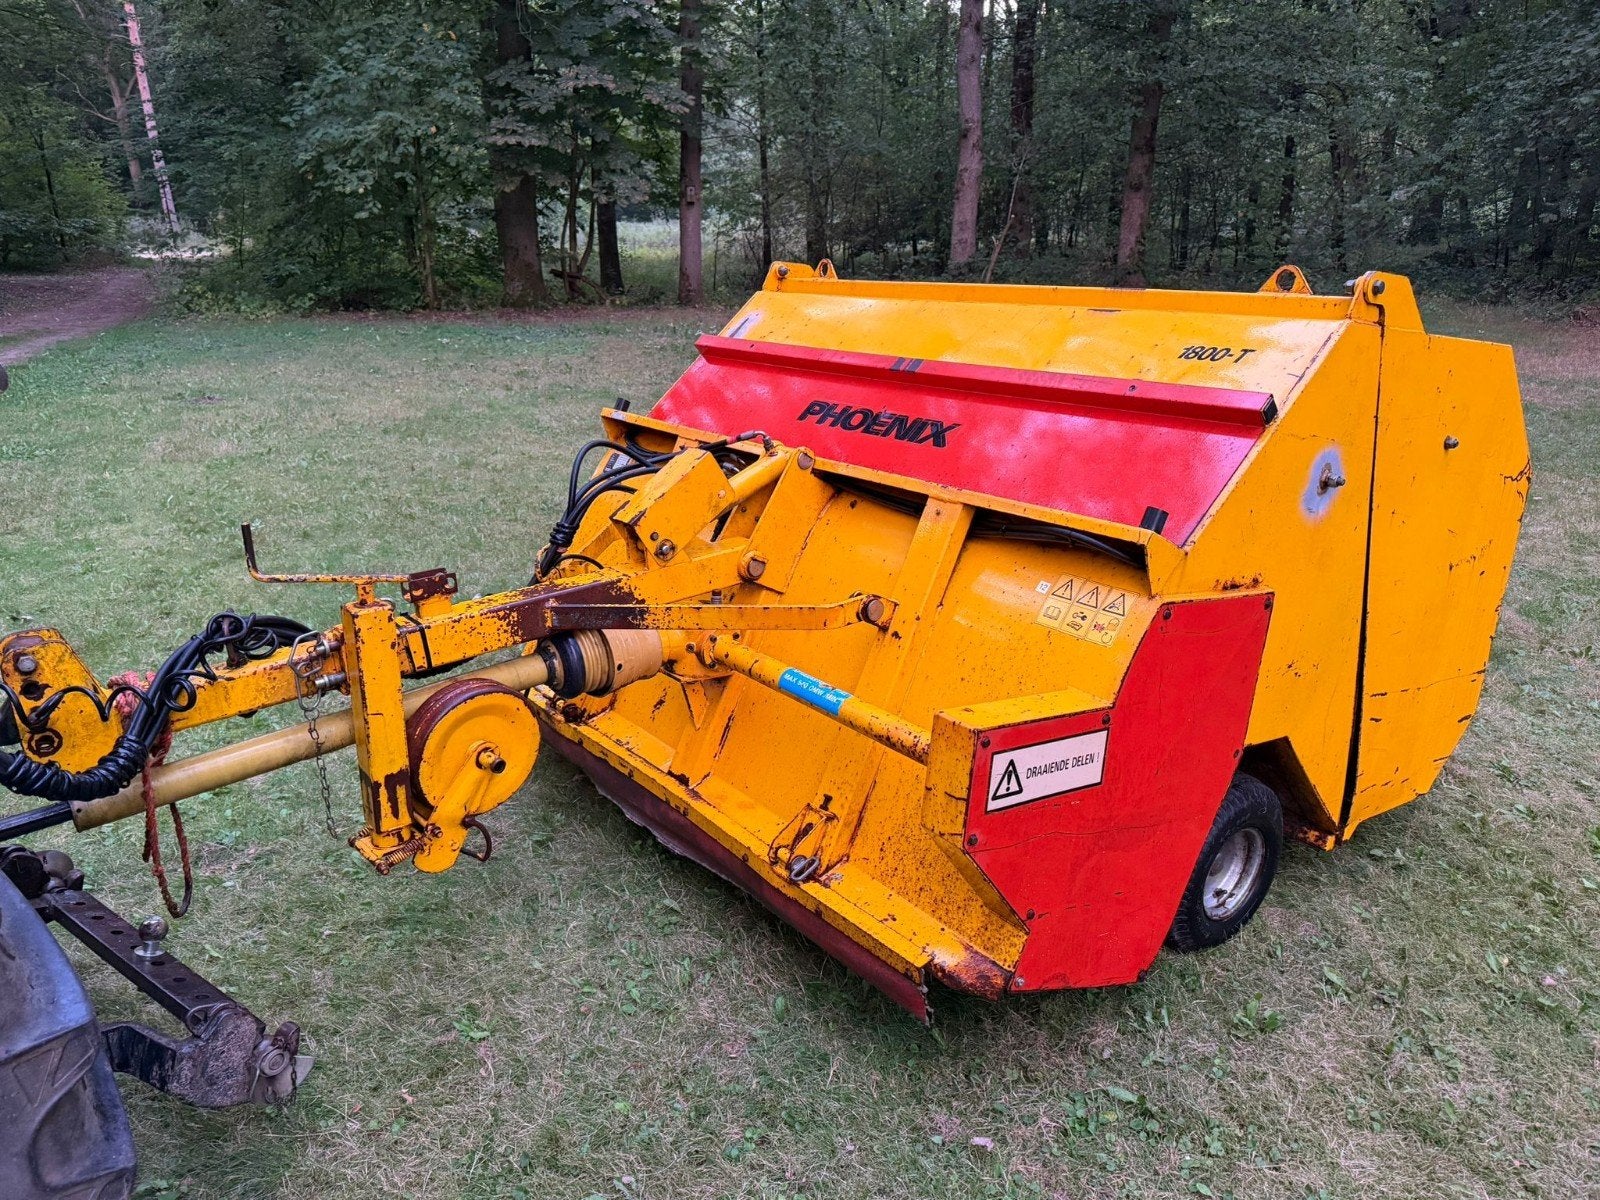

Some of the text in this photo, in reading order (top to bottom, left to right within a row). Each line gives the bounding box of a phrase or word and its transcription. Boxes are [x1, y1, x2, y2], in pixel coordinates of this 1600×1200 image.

[1178, 345, 1257, 363] 1800-T
[797, 400, 961, 448] PHOENIX
[784, 673, 798, 684] MAX
[1026, 758, 1070, 779] DRAAIENDE
[1071, 753, 1095, 768] DELEN
